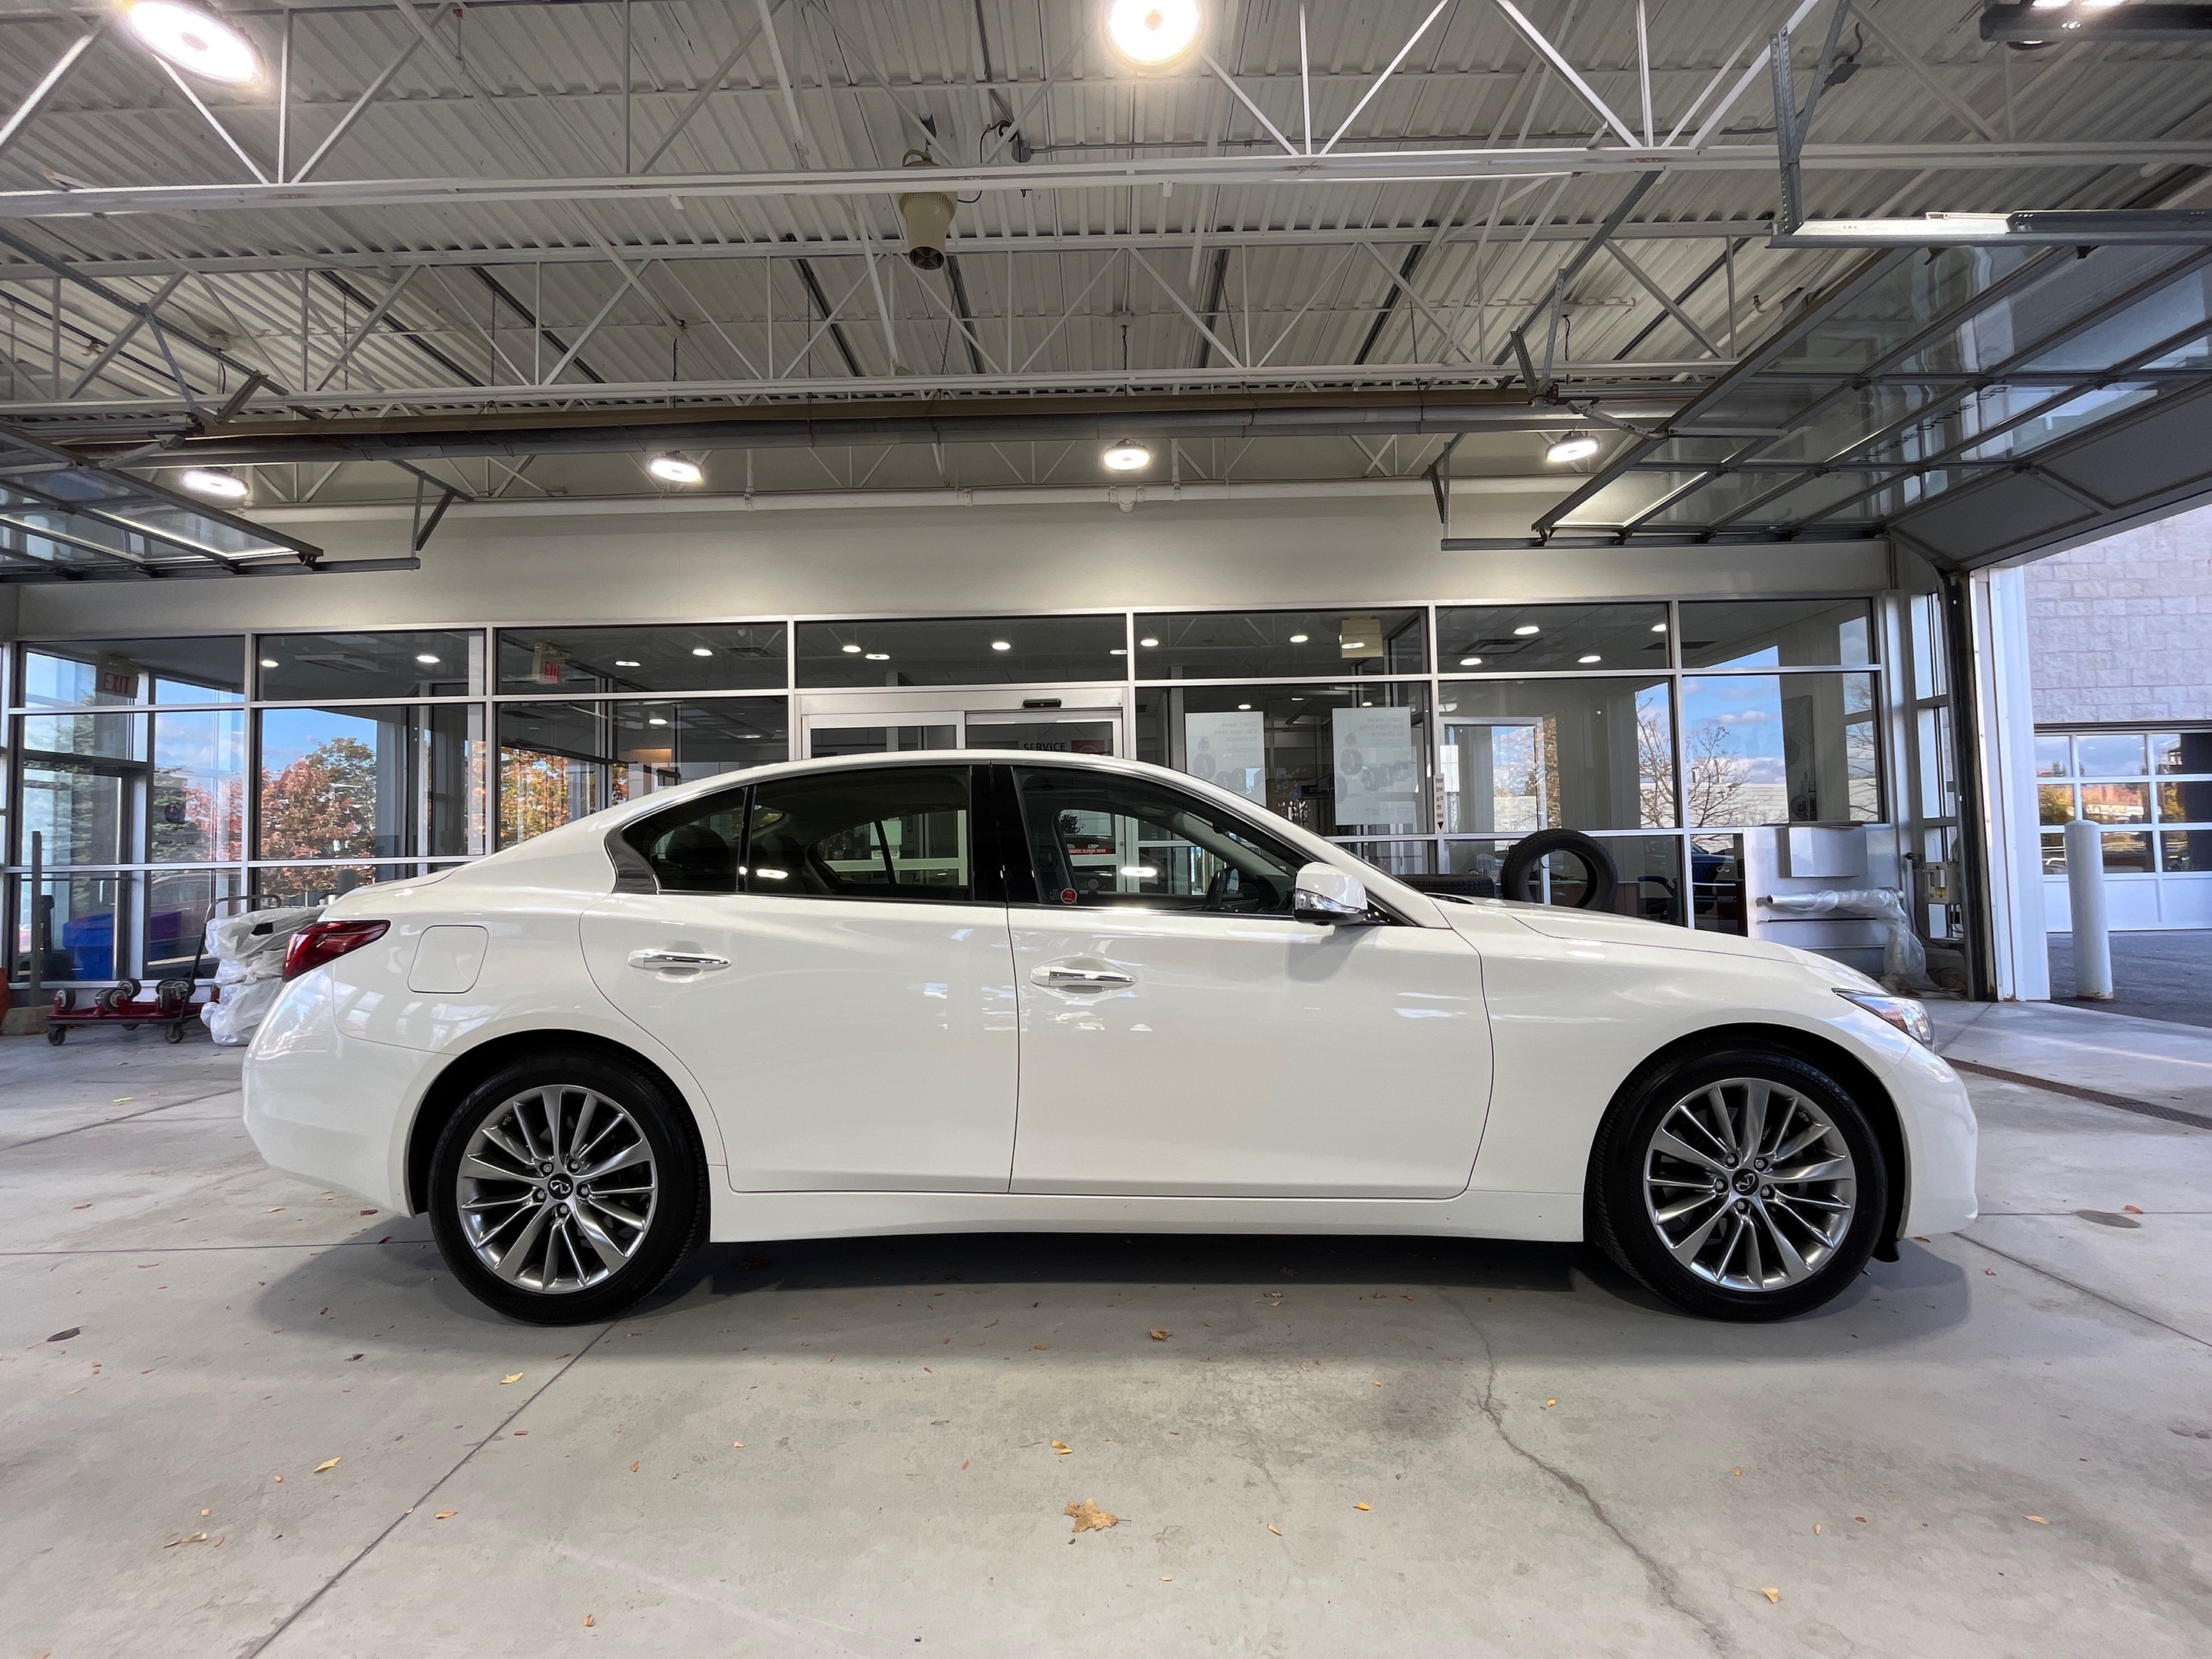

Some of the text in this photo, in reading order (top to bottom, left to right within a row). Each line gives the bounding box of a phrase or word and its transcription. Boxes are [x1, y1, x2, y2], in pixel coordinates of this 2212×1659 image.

[1916, 404, 1975, 431] Drive
[545, 660, 561, 682] EXIT
[102, 672, 131, 694] EXIT
[1023, 742, 1066, 752] SERVICE
